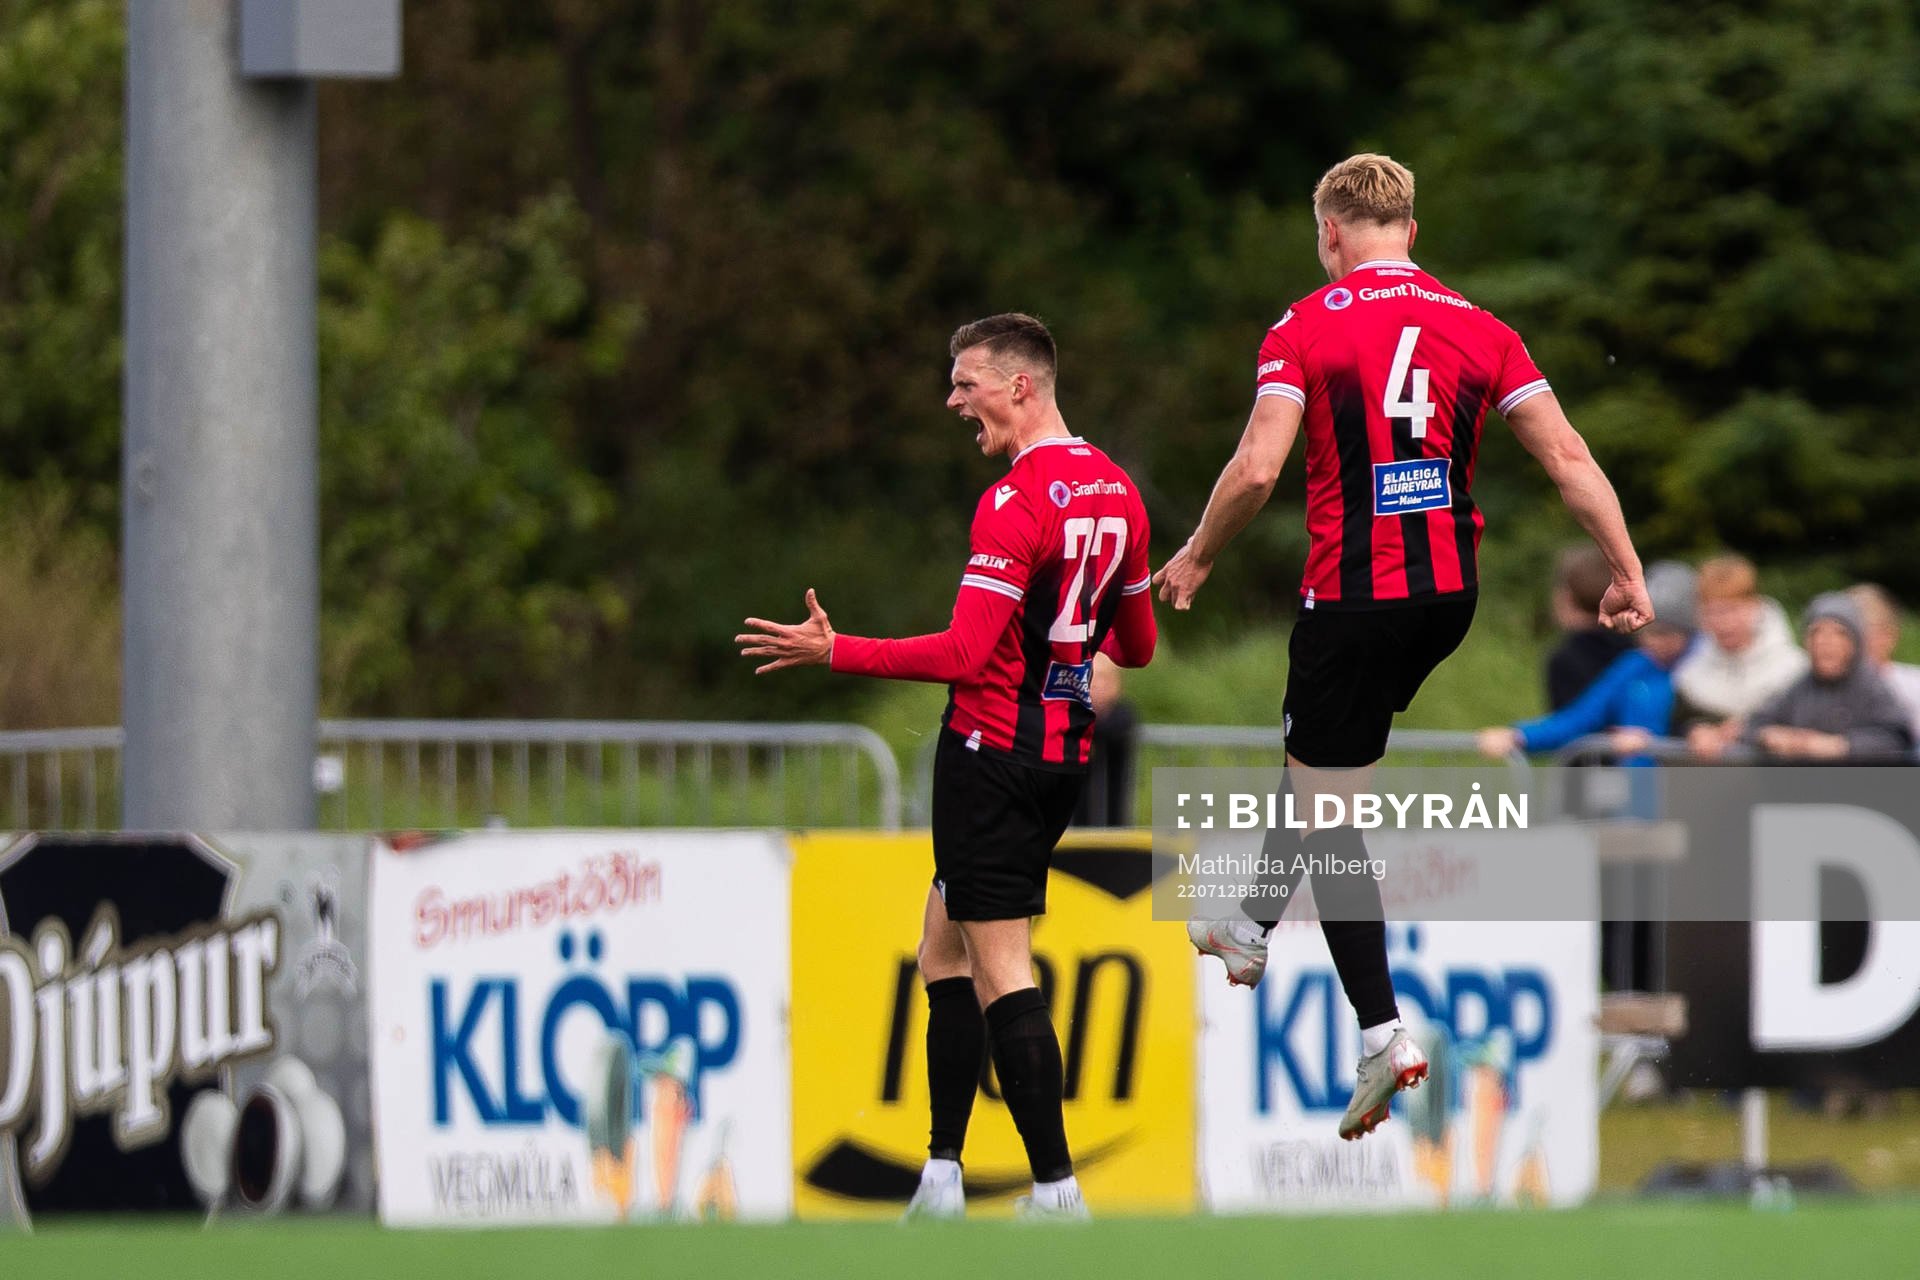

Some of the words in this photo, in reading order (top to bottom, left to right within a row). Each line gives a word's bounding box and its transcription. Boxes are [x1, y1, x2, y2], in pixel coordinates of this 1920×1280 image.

[1383, 326, 1436, 438] 4
[1048, 517, 1127, 642] 22
[429, 929, 742, 1126] KLÖPP
